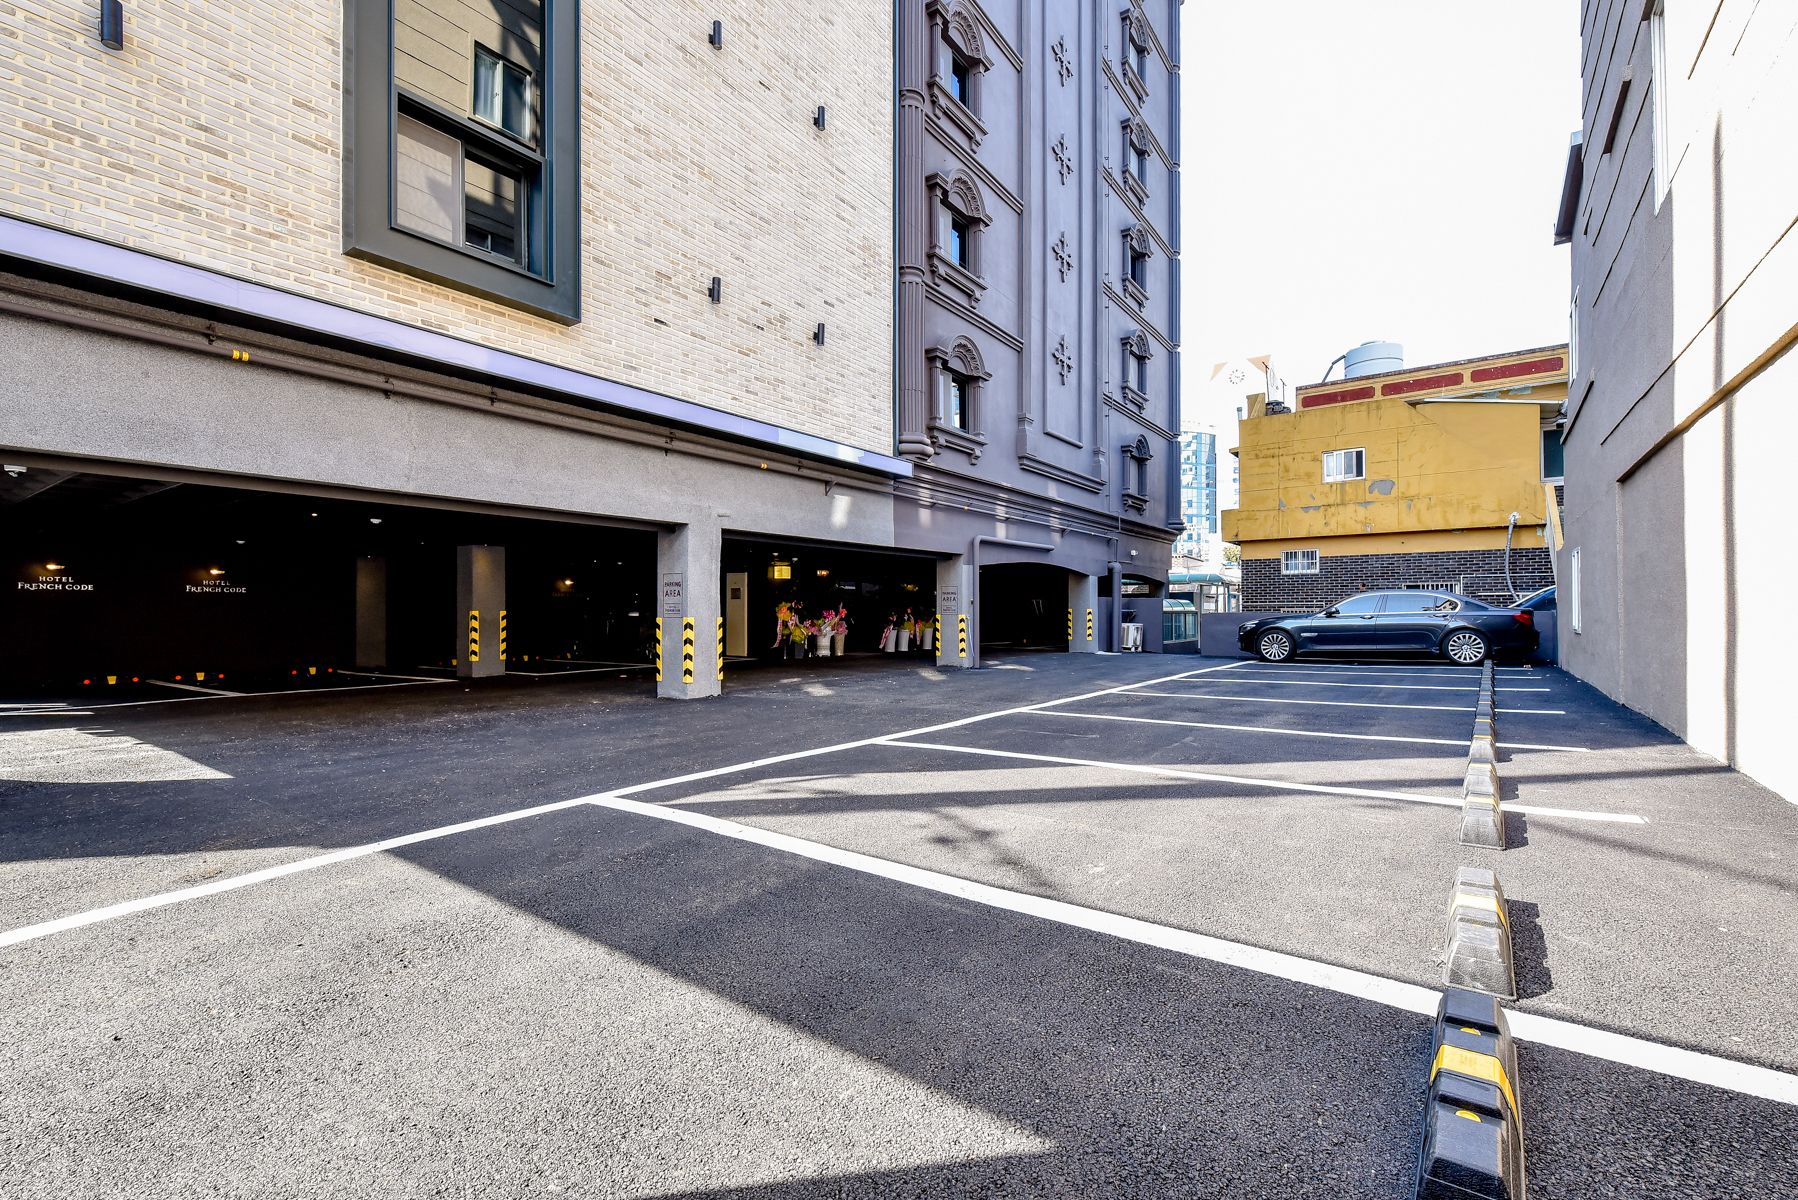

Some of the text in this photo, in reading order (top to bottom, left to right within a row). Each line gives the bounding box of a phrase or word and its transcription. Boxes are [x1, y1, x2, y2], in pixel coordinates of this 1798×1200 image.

[17, 582, 94, 591] FRENCH CODE
[185, 585, 222, 593] FRENCH
[664, 589, 681, 598] AREA
